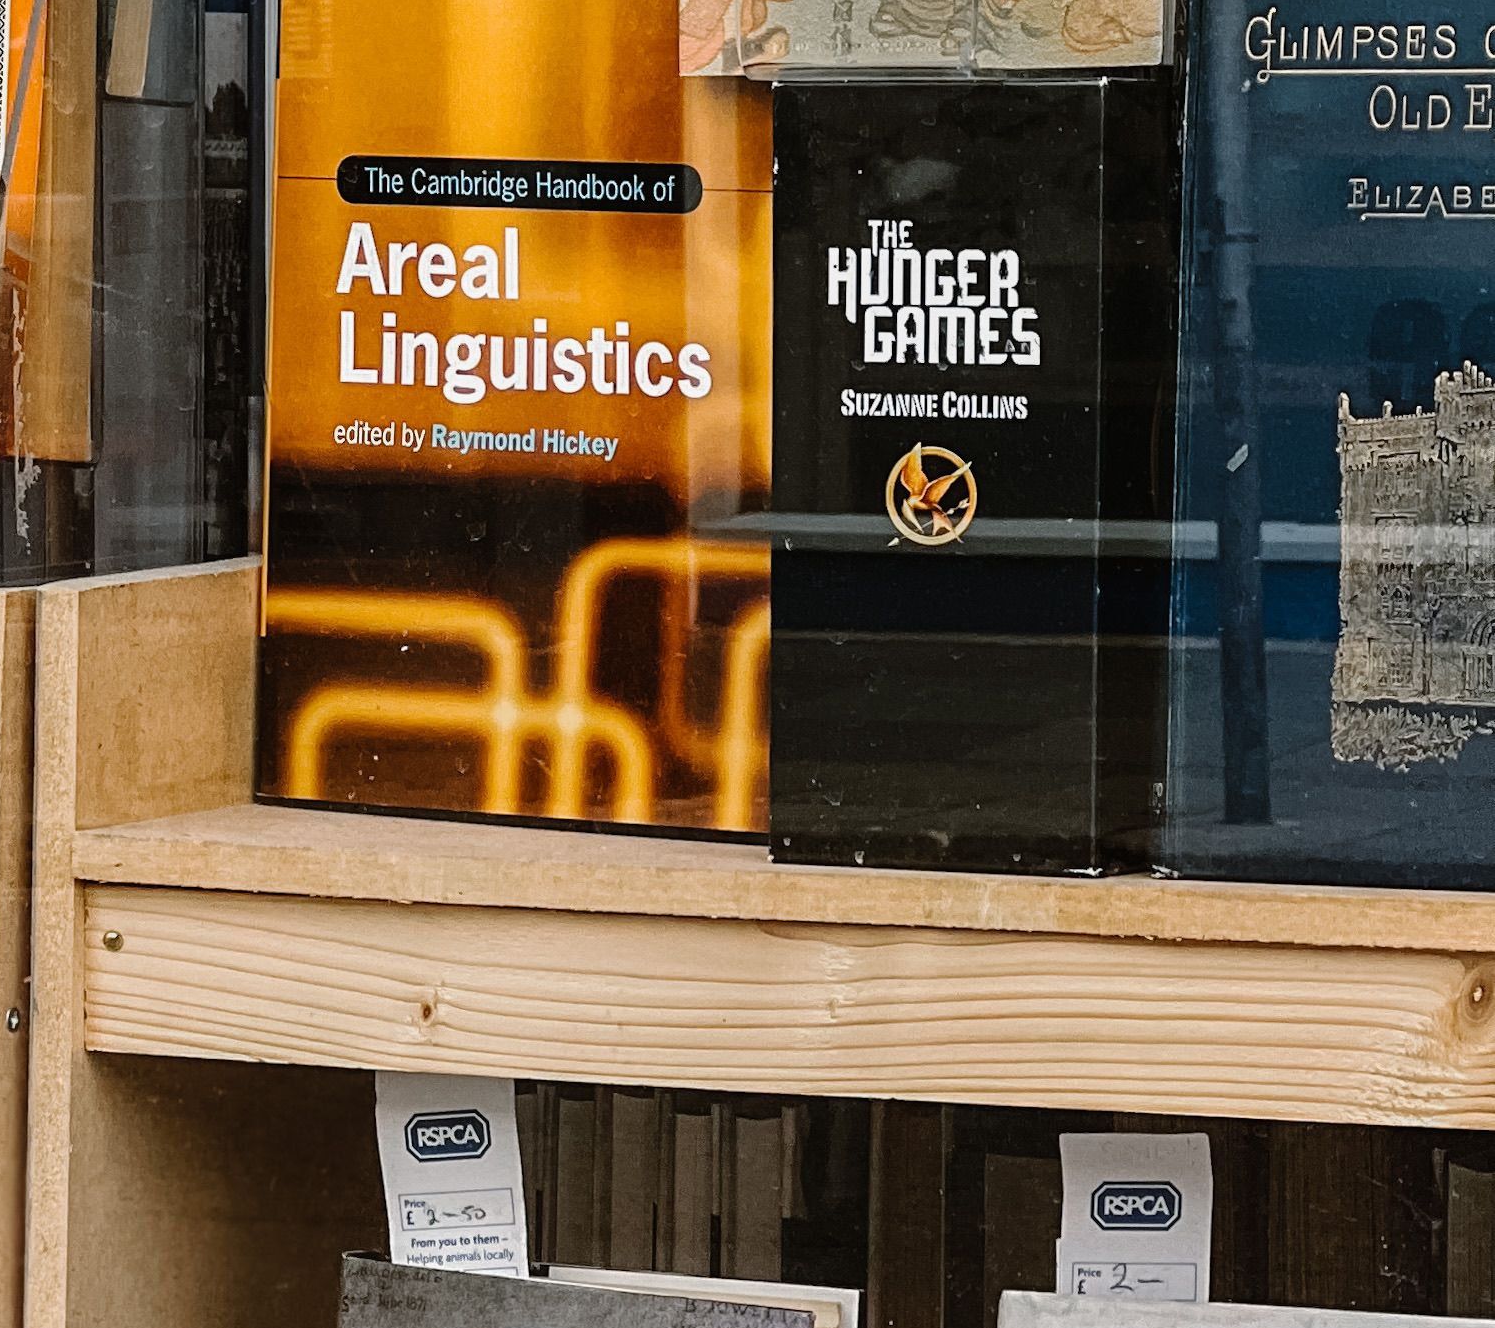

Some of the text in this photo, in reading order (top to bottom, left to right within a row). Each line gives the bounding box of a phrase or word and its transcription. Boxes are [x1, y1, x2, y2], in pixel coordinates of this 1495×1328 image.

[1245, 7, 1456, 76] GLIMPSES
[1369, 84, 1451, 130] OLD
[364, 167, 675, 202] The Cambridge Handbook of
[868, 219, 914, 253] THE
[336, 221, 519, 300] Areal
[827, 247, 1020, 324] HUNGER
[864, 306, 1041, 365] GAMES
[339, 310, 713, 404] Linguistics
[840, 388, 1028, 420] SUZANNE COLLINS
[333, 420, 619, 462] edited by Raymond Hickey
[417, 1124, 480, 1148] RSPCA
[1104, 1195, 1170, 1216] RSPCA
[407, 1249, 514, 1265] Helping animals locally
[411, 1234, 500, 1248] From you to them
